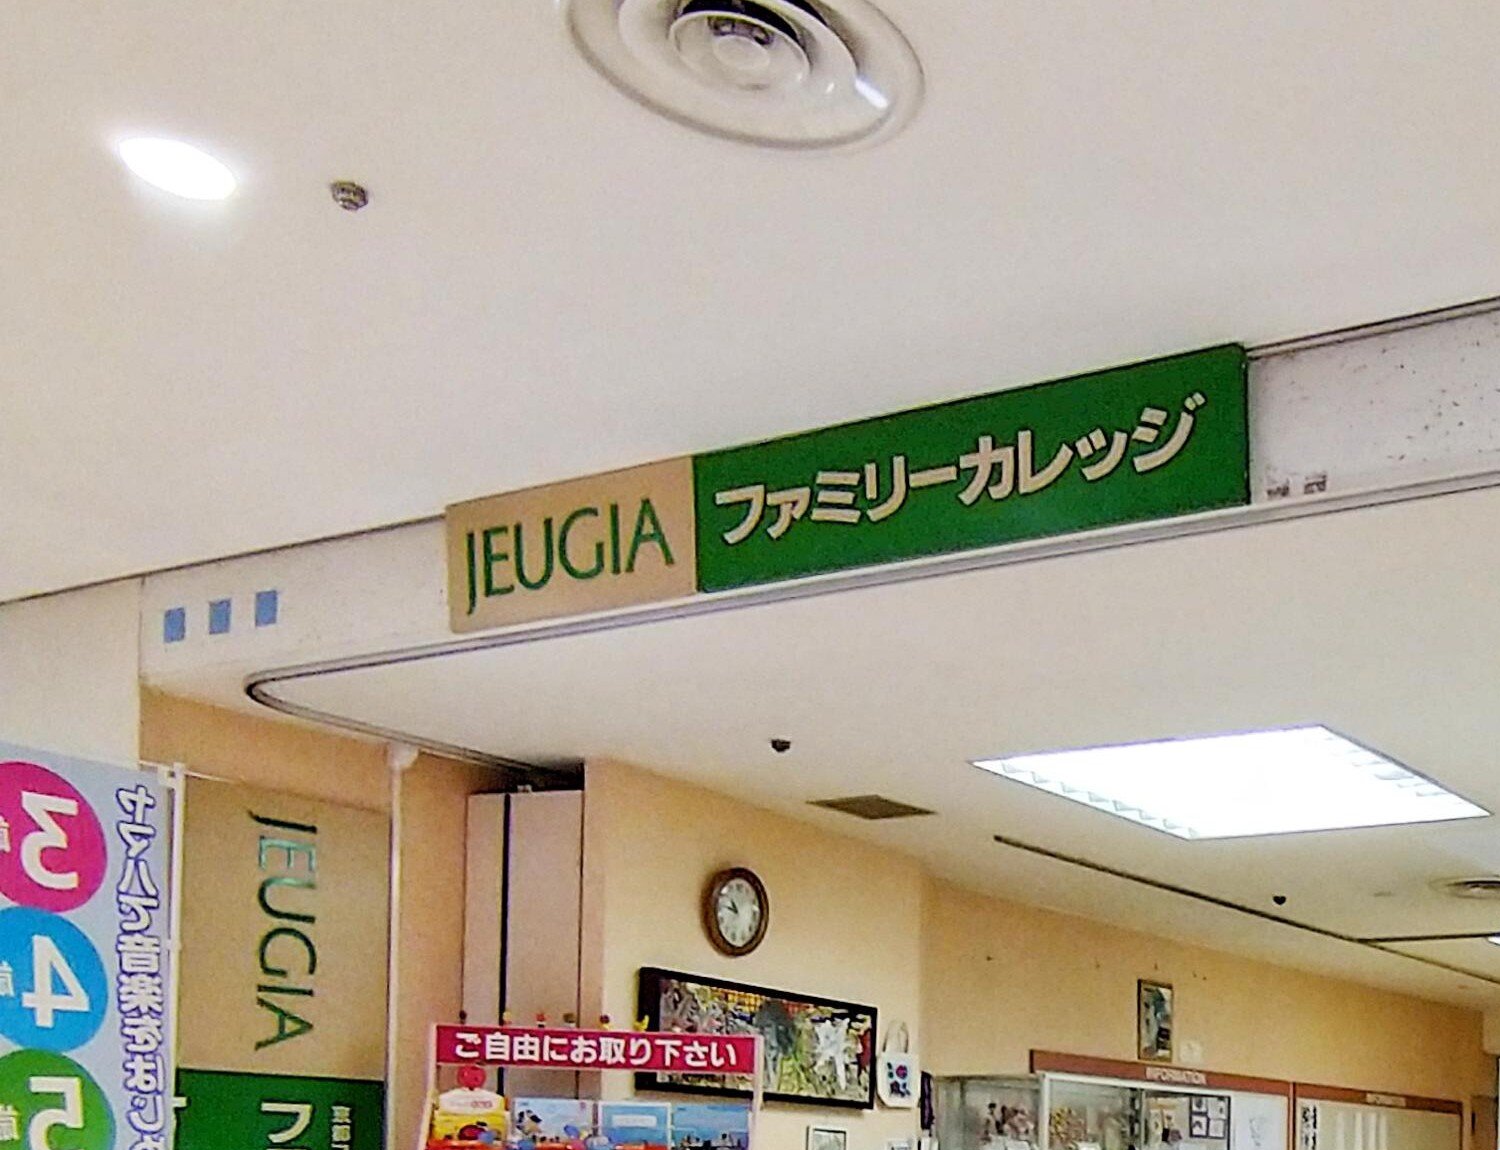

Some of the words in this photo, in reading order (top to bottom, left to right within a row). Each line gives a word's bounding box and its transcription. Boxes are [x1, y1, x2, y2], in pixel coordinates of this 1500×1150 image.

[464, 498, 674, 614] JEUGIA
[714, 392, 1206, 545] ファミリーカレッジ
[248, 810, 319, 1052] JEUGIA
[454, 1031, 738, 1067] ご自由にお取り下さい
